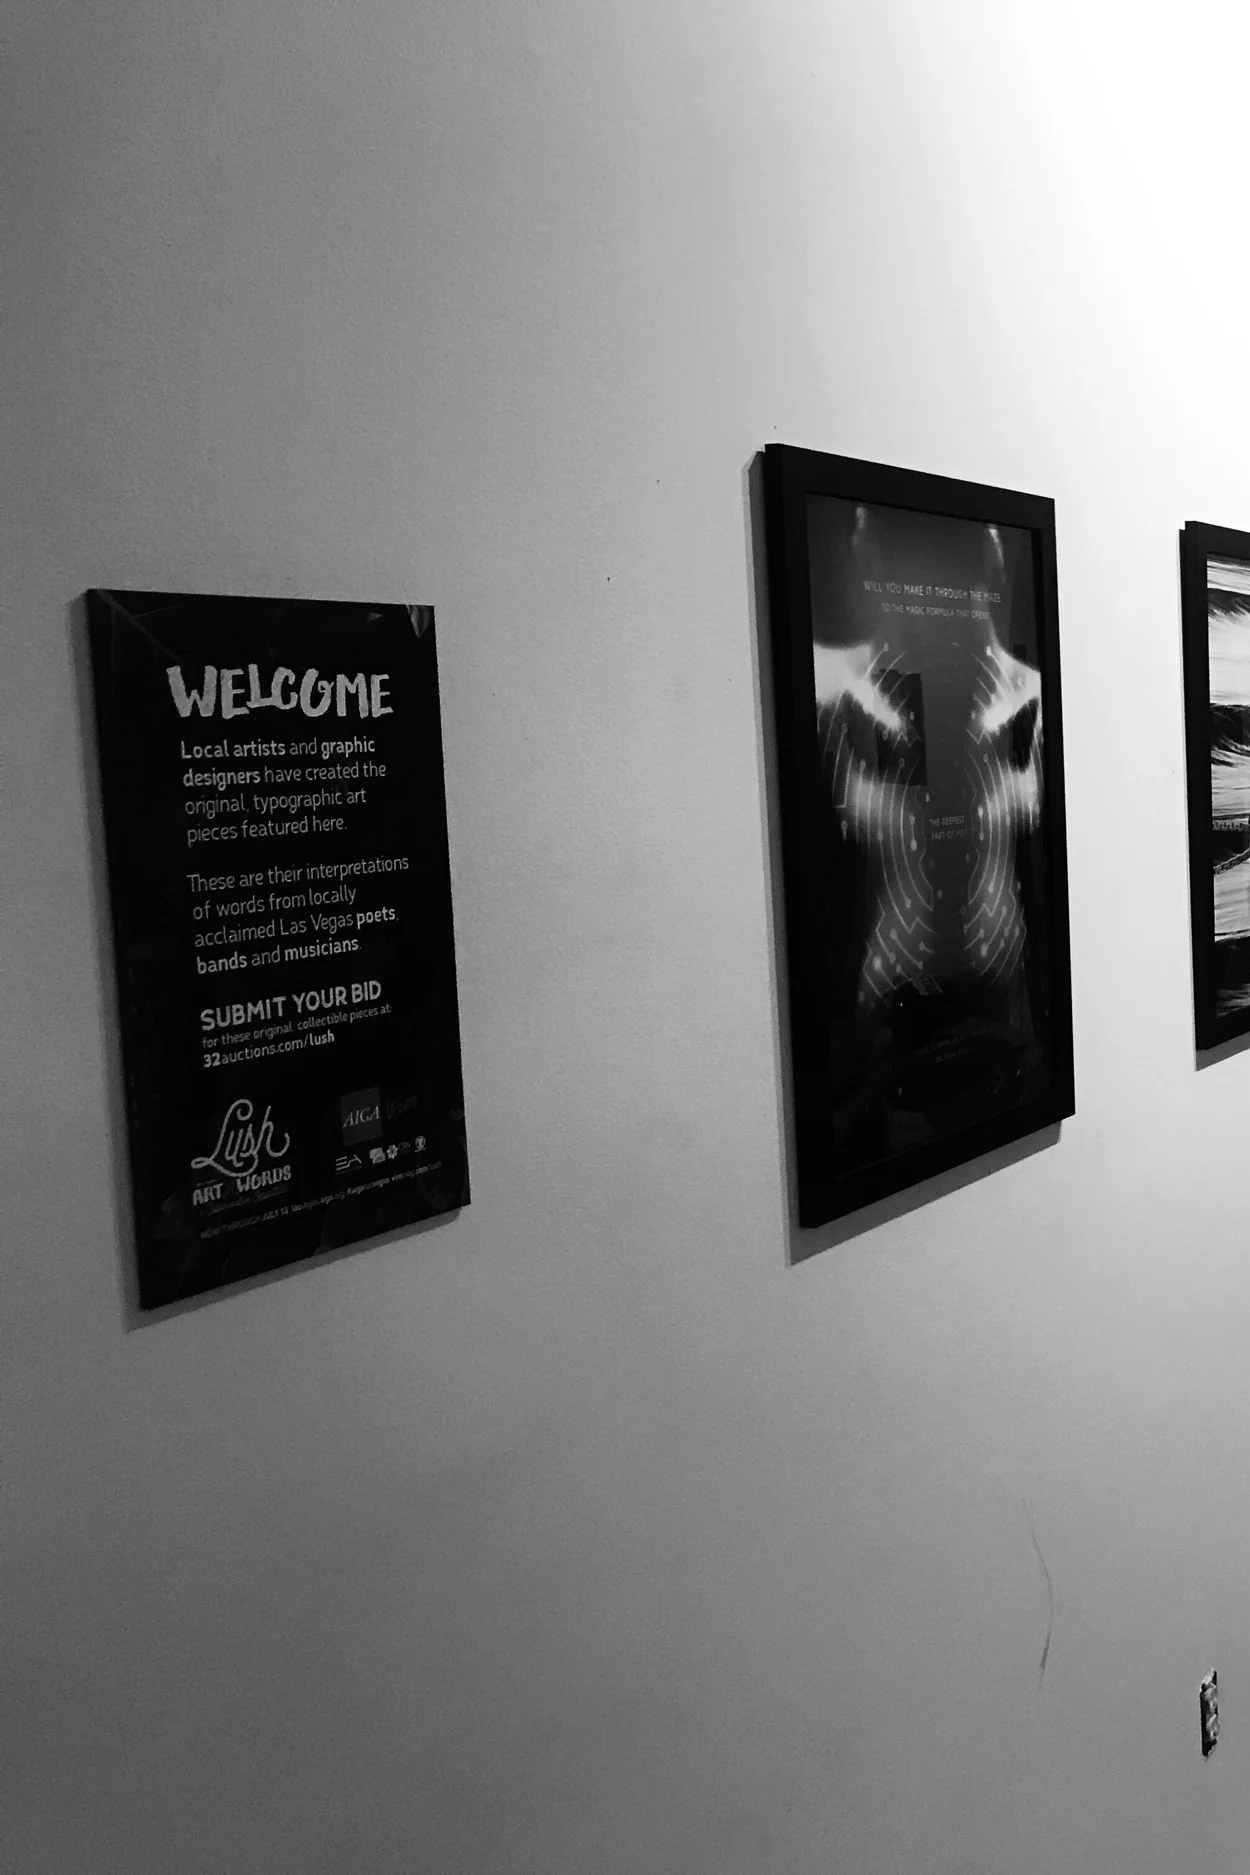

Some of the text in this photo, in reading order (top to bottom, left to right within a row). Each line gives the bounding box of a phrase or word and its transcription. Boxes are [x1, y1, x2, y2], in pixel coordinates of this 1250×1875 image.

[862, 580, 883, 593] WILL
[885, 582, 901, 594] YOU
[903, 584, 924, 597] MAKE
[925, 585, 933, 597] IT
[934, 587, 968, 600] THROUGH
[969, 590, 983, 602] THE
[166, 663, 393, 719] WELCOME
[180, 735, 375, 760] Local artists and graphic
[183, 760, 387, 791] designers have created the
[184, 788, 367, 820] original, typographic art
[187, 815, 348, 848] pieces featured here.
[186, 856, 409, 893] These are their interpretations
[193, 886, 357, 920] of words from locally
[194, 906, 399, 948] acclaimed Las Vegas poets,
[196, 936, 362, 974] bands and musicians.
[200, 980, 382, 1031] SUBMIT YOUR BID
[202, 1035, 218, 1050] for
[221, 1029, 251, 1046] these
[253, 1021, 292, 1043] original
[297, 1012, 348, 1031] collectible
[350, 1007, 378, 1024] pieces
[203, 1029, 335, 1068] 32auctions.com/lush
[342, 1104, 382, 1129] AIGA
[191, 1098, 291, 1177] Lush
[192, 1182, 224, 1206] ART
[236, 1164, 292, 1193] WORDS
